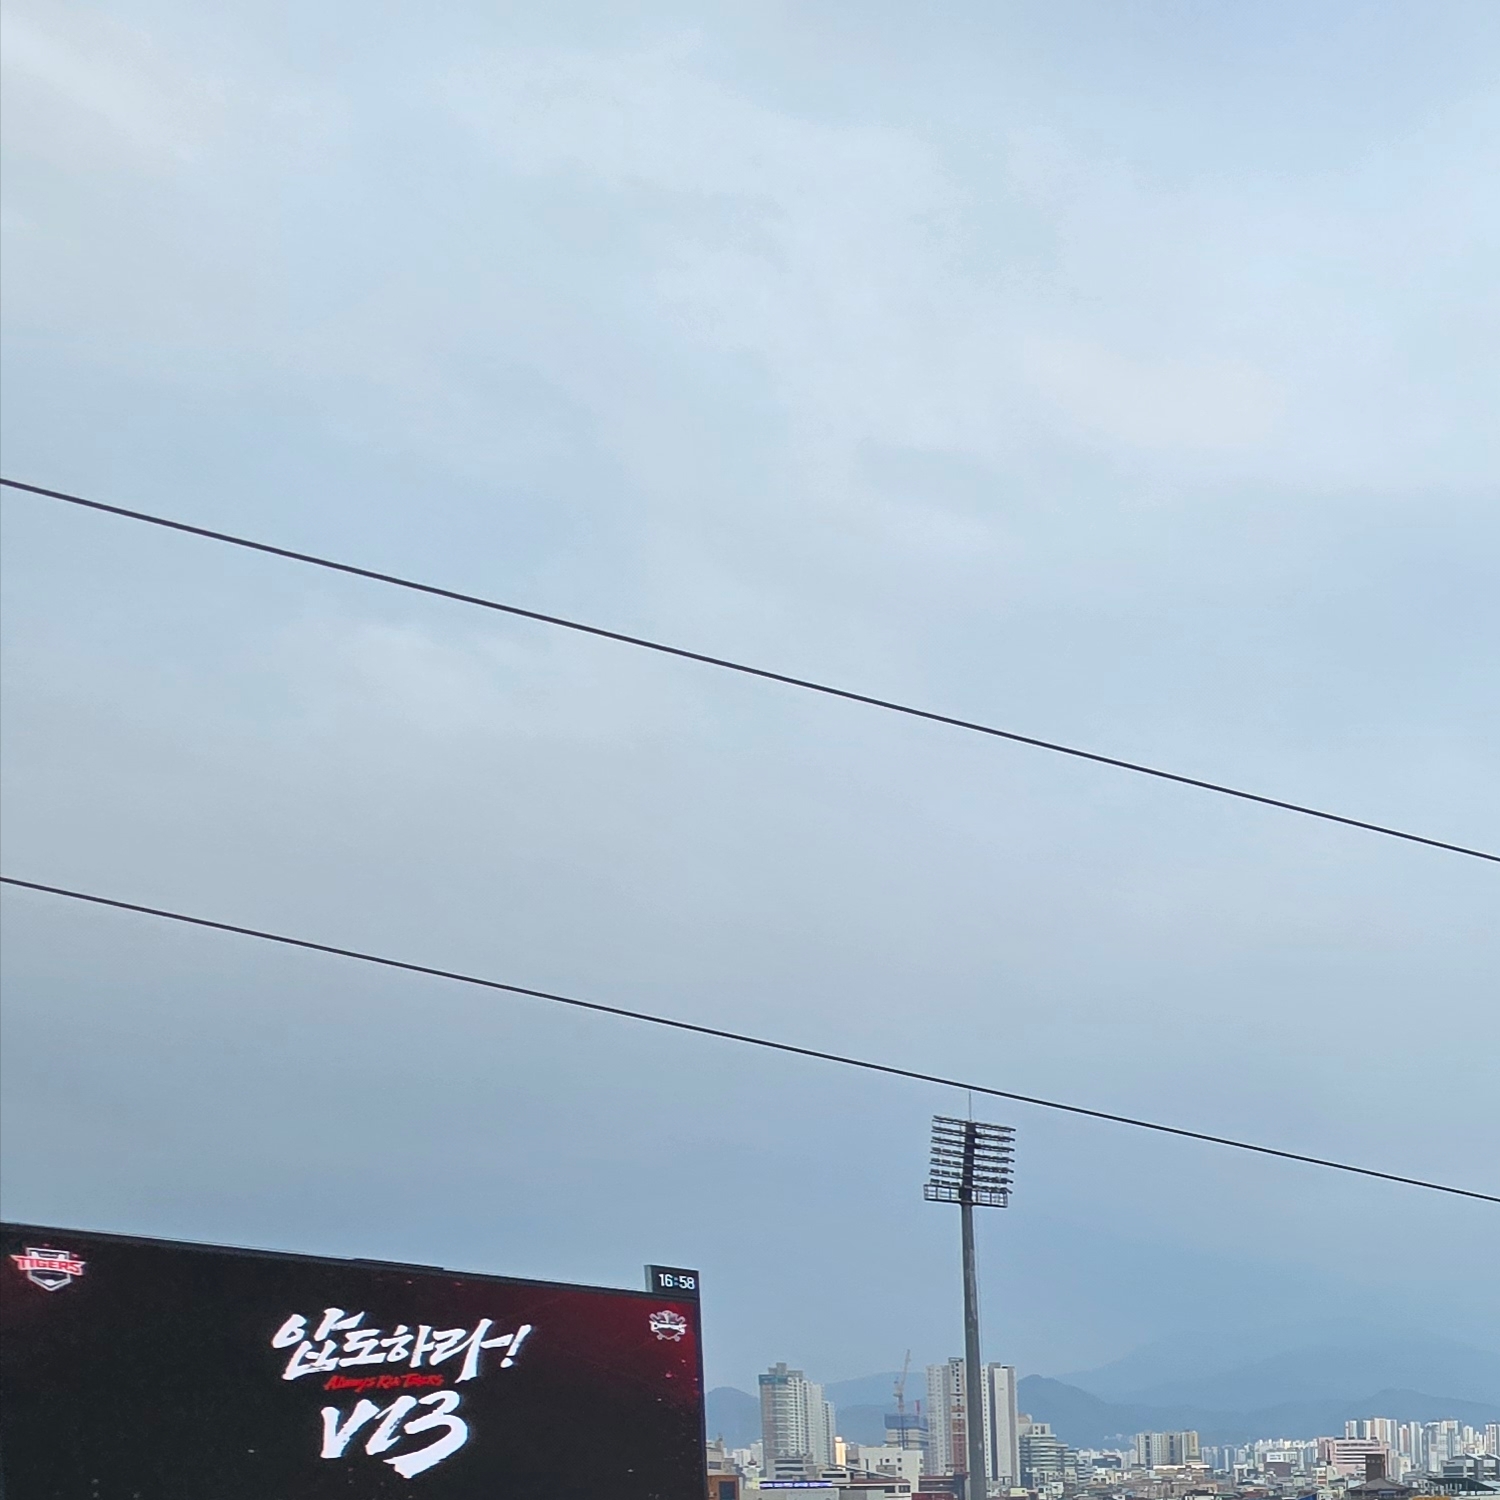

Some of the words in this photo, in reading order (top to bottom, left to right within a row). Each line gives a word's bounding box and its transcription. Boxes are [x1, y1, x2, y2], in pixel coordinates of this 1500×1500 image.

[18, 1257, 84, 1275] TIGERS
[659, 1273, 695, 1290] 16:58
[272, 1307, 532, 1384] 압도하라!
[319, 1390, 468, 1479] V13
